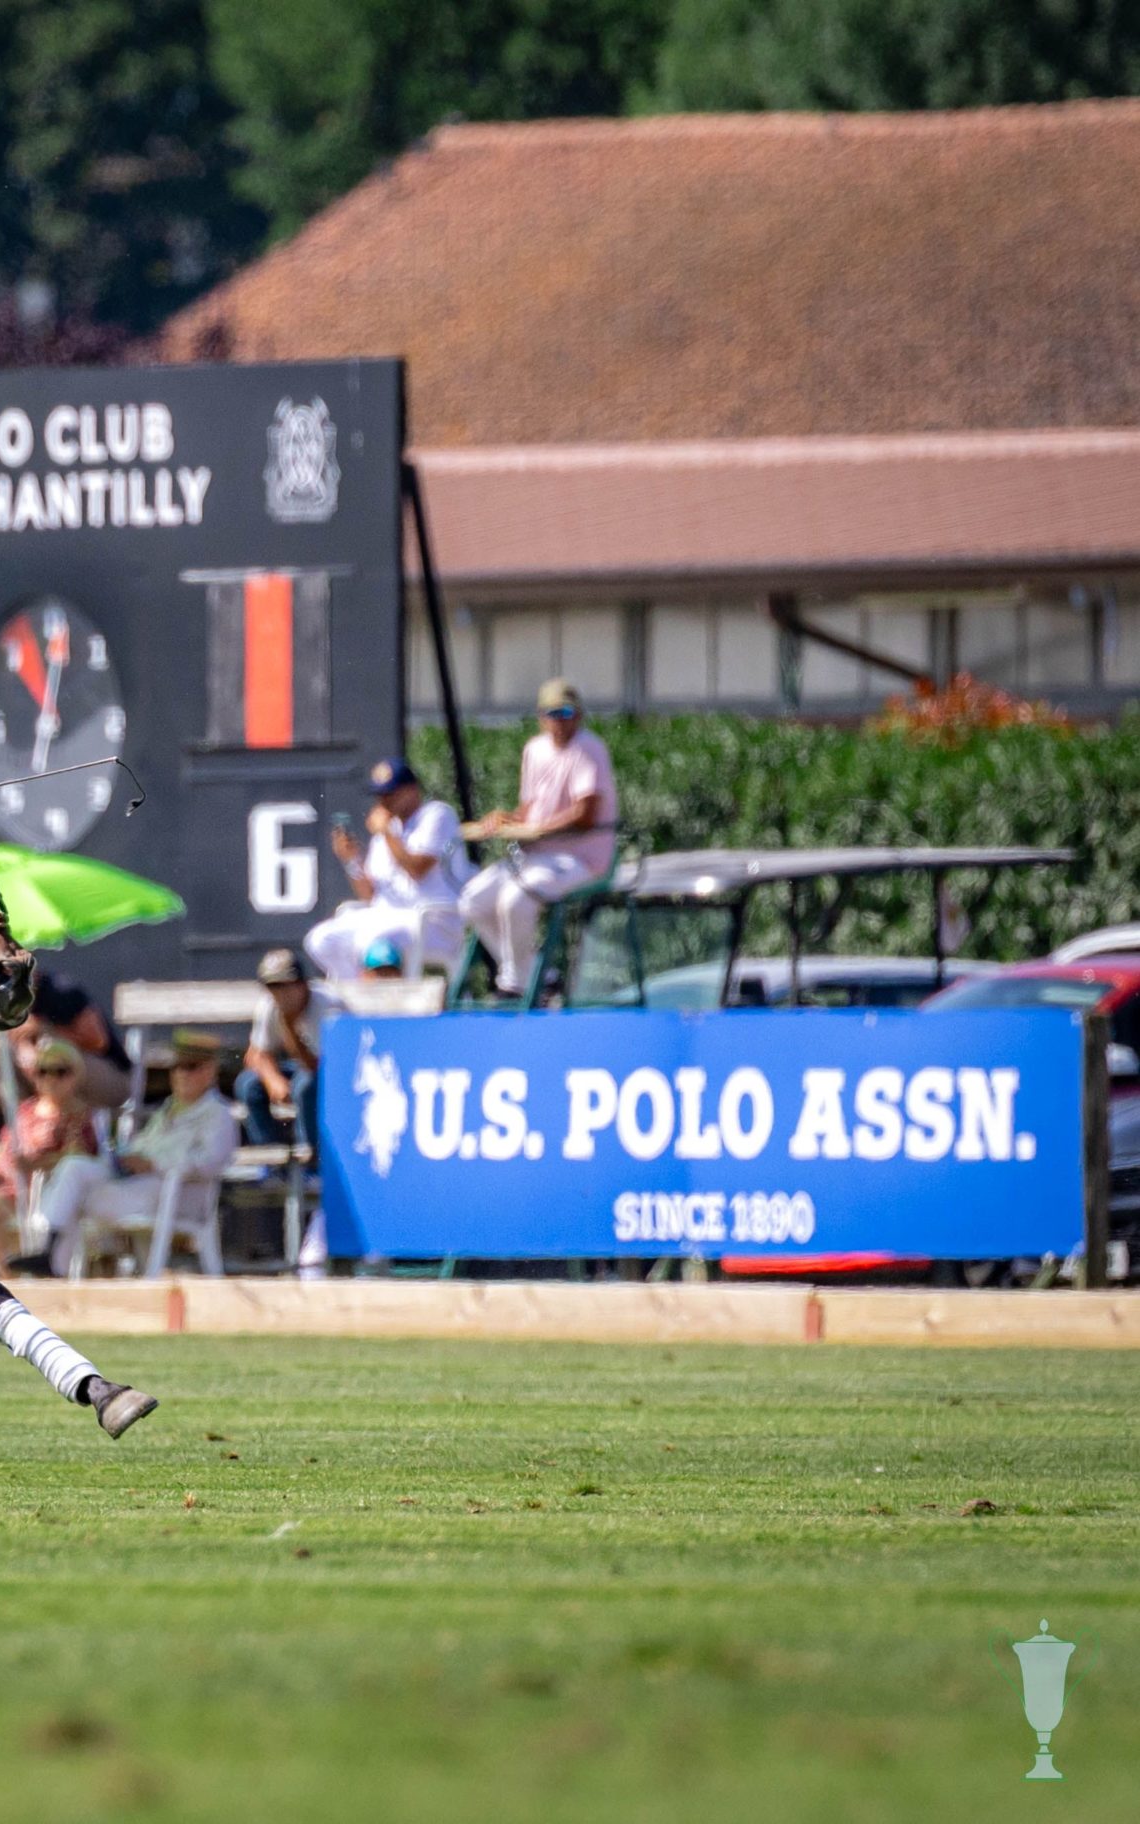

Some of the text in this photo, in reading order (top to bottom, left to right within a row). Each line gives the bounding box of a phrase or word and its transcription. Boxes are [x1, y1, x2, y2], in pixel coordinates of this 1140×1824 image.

[44, 403, 176, 464] CLUB
[247, 802, 321, 914] 6
[410, 1066, 1037, 1162] U.S. POLO ASSN.
[613, 1191, 815, 1243] SINCE 1890
